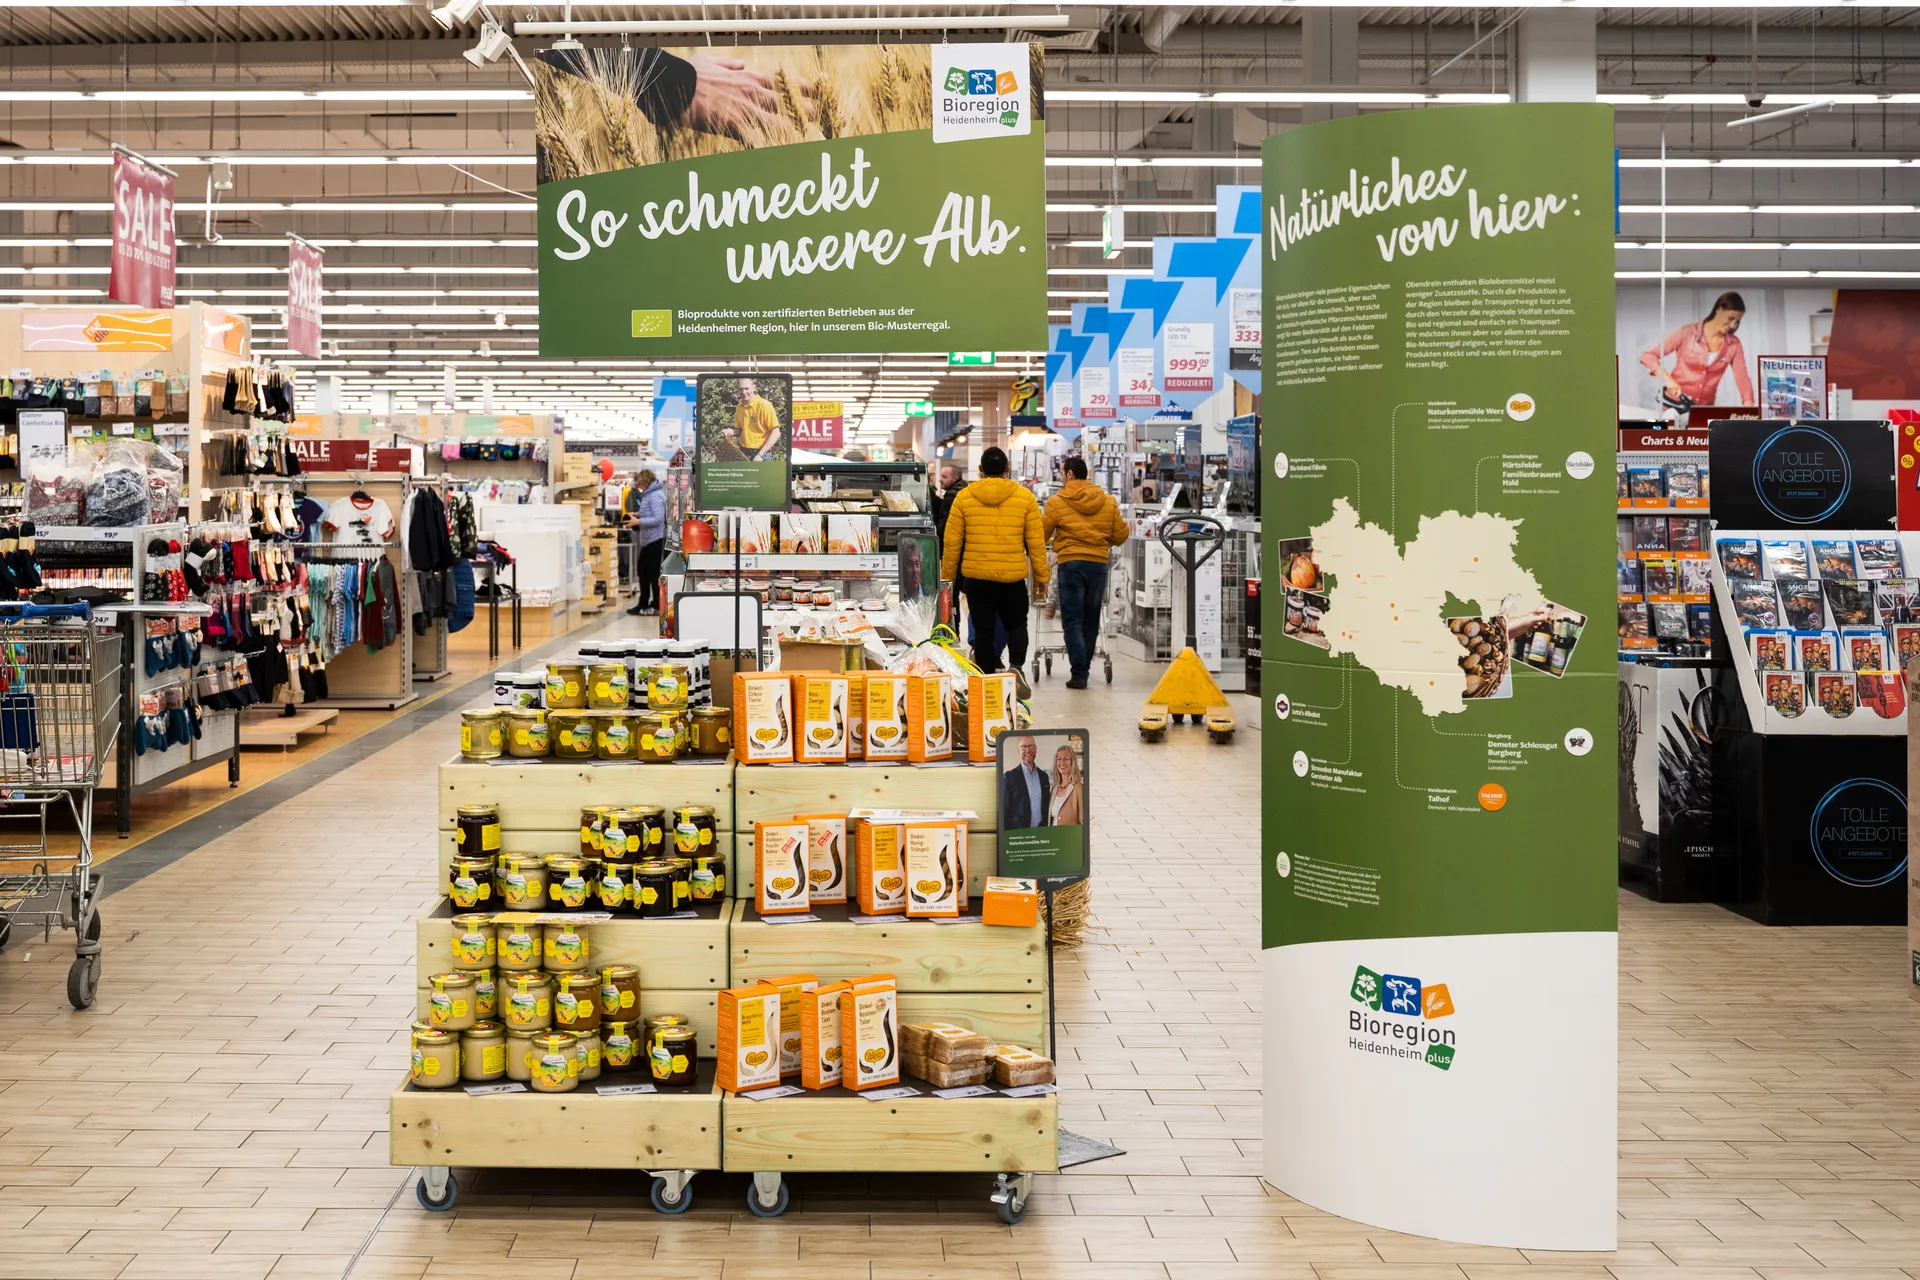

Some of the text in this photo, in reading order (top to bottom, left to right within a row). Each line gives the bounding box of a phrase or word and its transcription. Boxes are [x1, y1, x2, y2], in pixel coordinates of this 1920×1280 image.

[943, 98, 1019, 114] Bioregion
[943, 116, 1017, 124] Heidenheim plus
[554, 147, 880, 261] So schmeckt
[1270, 156, 1467, 262] Natürliches
[119, 180, 171, 255] SALE
[1376, 188, 1581, 262] von hier:
[727, 191, 1027, 284] unsere Alb.
[1406, 291, 1433, 299] weniger
[1435, 289, 1480, 297] Zusatzstoffe.
[678, 306, 915, 321] Bioprodukte von zertifizierten Betrieben aus der
[1483, 309, 1516, 317] regionale
[678, 320, 951, 334] Heidenheimer Region, hier in unserem Bio-Musterregal.
[1433, 320, 1461, 328] regional
[1406, 340, 1460, 348] Bio-Musterregal
[1431, 361, 1449, 369] liegt.
[1763, 360, 1823, 370] NEUHEITEN
[1167, 379, 1211, 387] REDUZIERT!
[1641, 436, 1674, 446] Charts
[1676, 436, 1684, 446] &
[296, 441, 330, 457] ALE
[1779, 452, 1824, 466] TOLLE
[1762, 469, 1841, 483] ANGEBOTE
[1520, 742, 1557, 750] Schlossgut
[1488, 749, 1521, 758] Burgberg
[1840, 808, 1889, 822] TOLLE
[1821, 827, 1908, 841] ANGEBOTE
[1622, 836, 1640, 849] STAFFEL
[1350, 1010, 1456, 1046] Bioregion
[1349, 1037, 1451, 1065] Heidenheim plus
